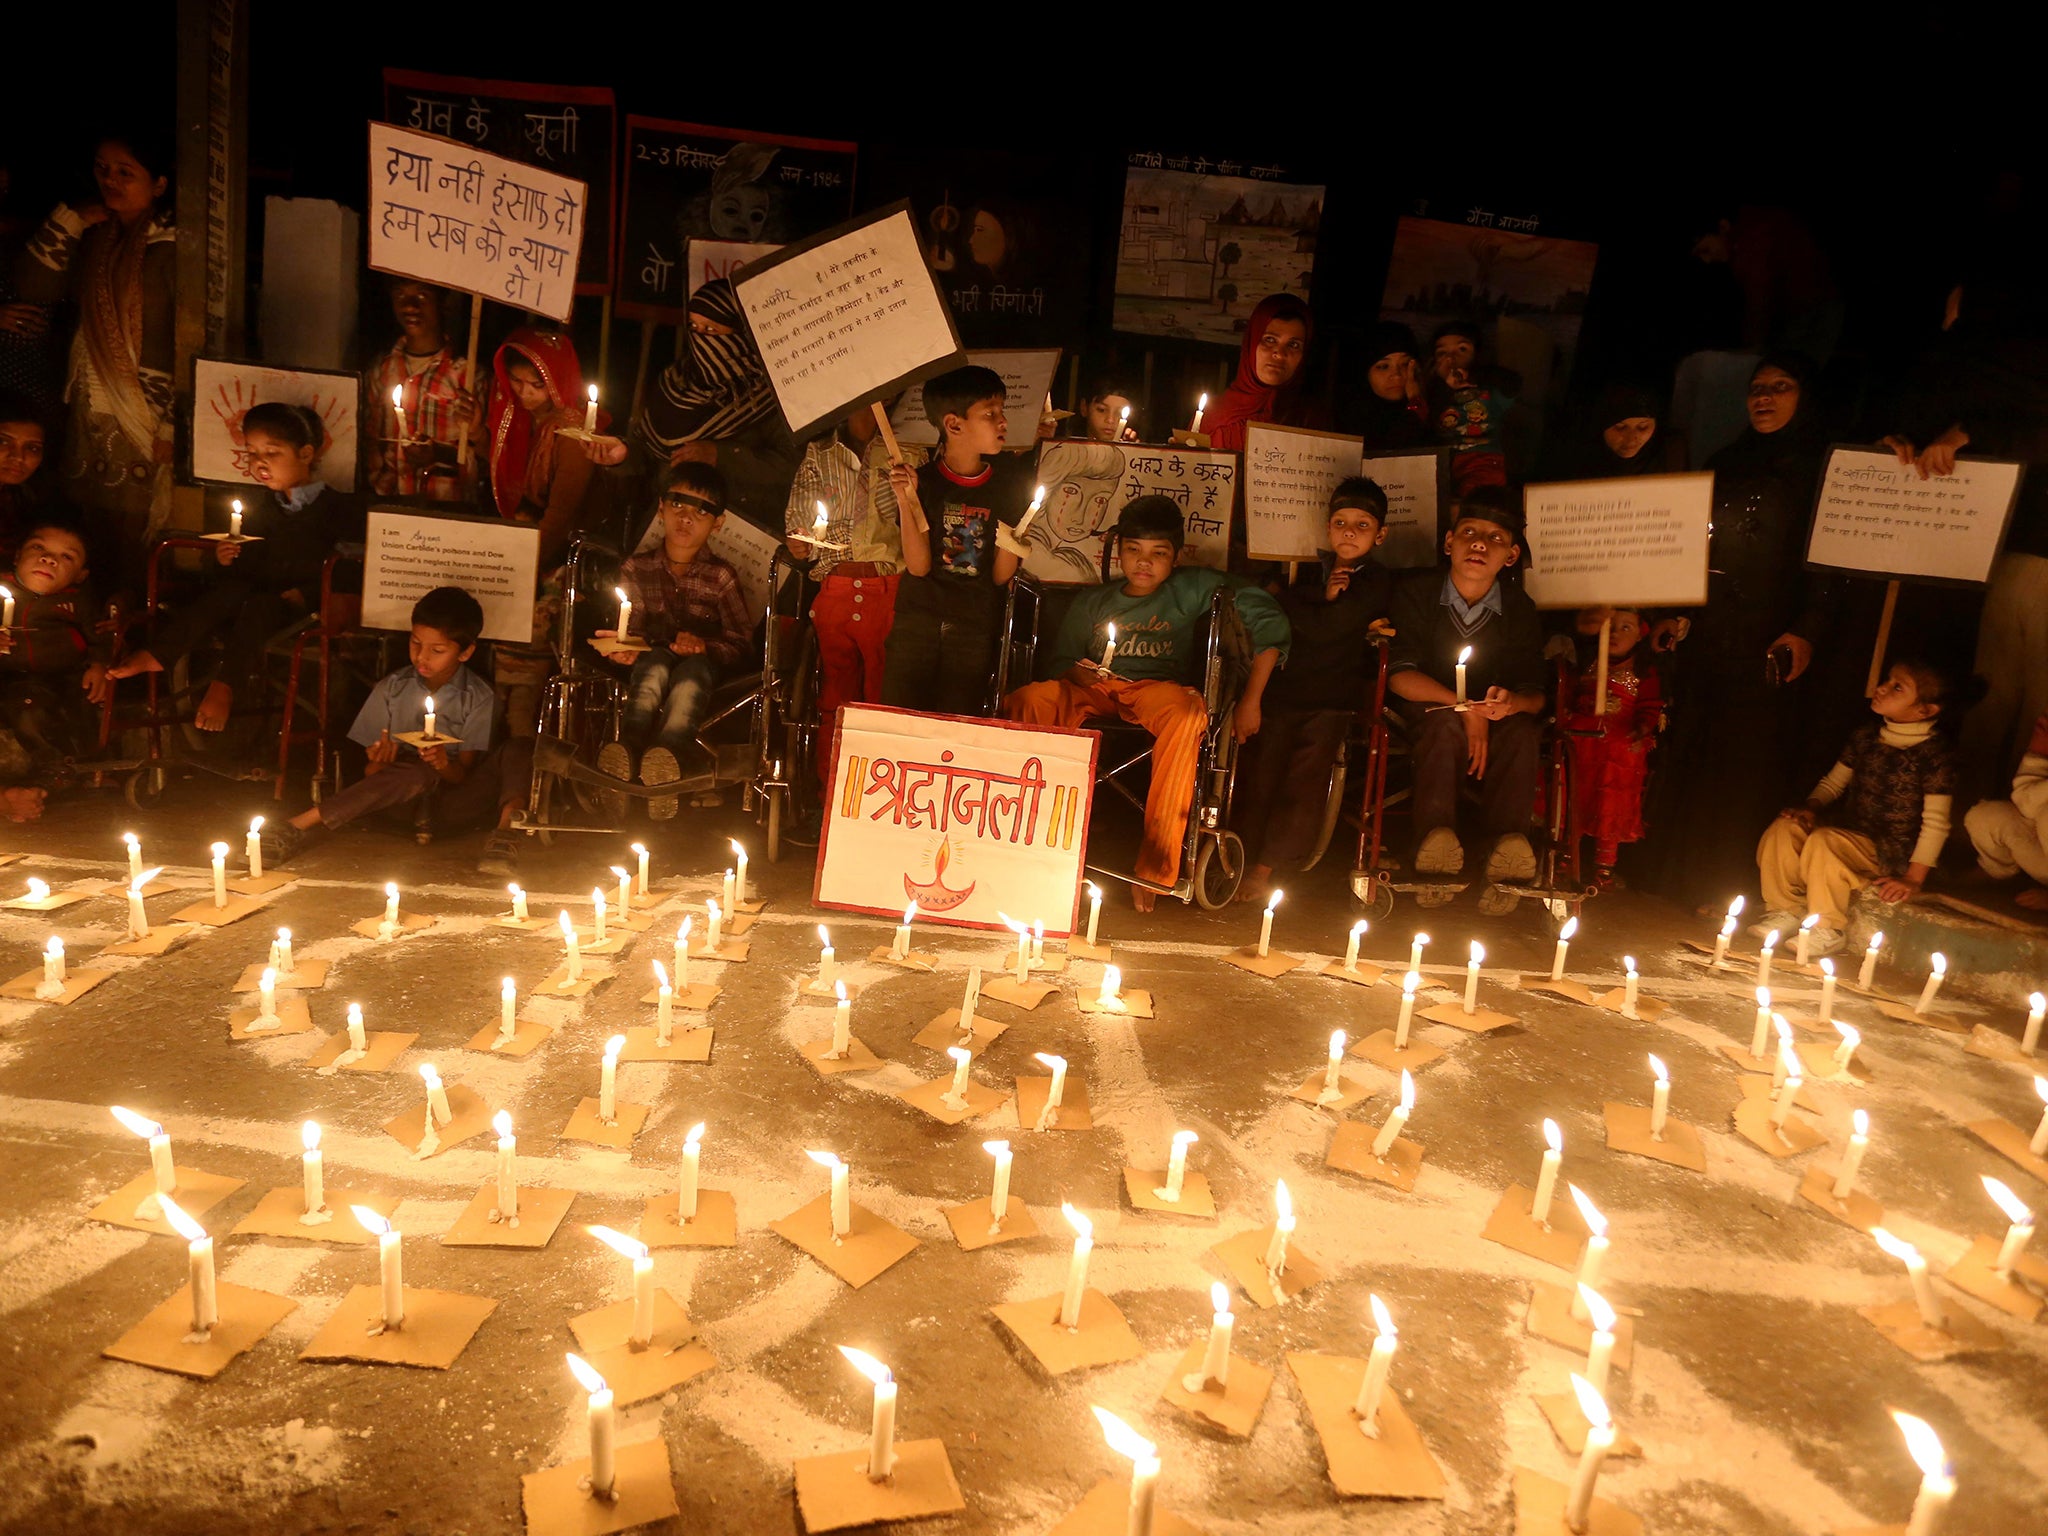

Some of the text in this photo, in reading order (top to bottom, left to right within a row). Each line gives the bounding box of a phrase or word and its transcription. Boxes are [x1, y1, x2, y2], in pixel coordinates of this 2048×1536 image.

[406, 95, 580, 160] डाव के खूनी
[635, 143, 671, 166] 2-3
[386, 146, 432, 193] दया
[438, 160, 485, 205] नहीं
[555, 188, 578, 235] दो
[381, 201, 570, 277] हम सब को न्याय
[504, 264, 529, 299] दो
[1168, 455, 1186, 478] के
[1193, 463, 1234, 484] कहर
[1125, 475, 1144, 500] से
[1187, 511, 1224, 536] तिल
[381, 541, 404, 549] Union
[379, 566, 431, 577] Governments
[380, 553, 421, 563] Chemical's
[452, 560, 470, 568] have
[472, 563, 501, 571] maimed
[478, 588, 514, 597] treatment
